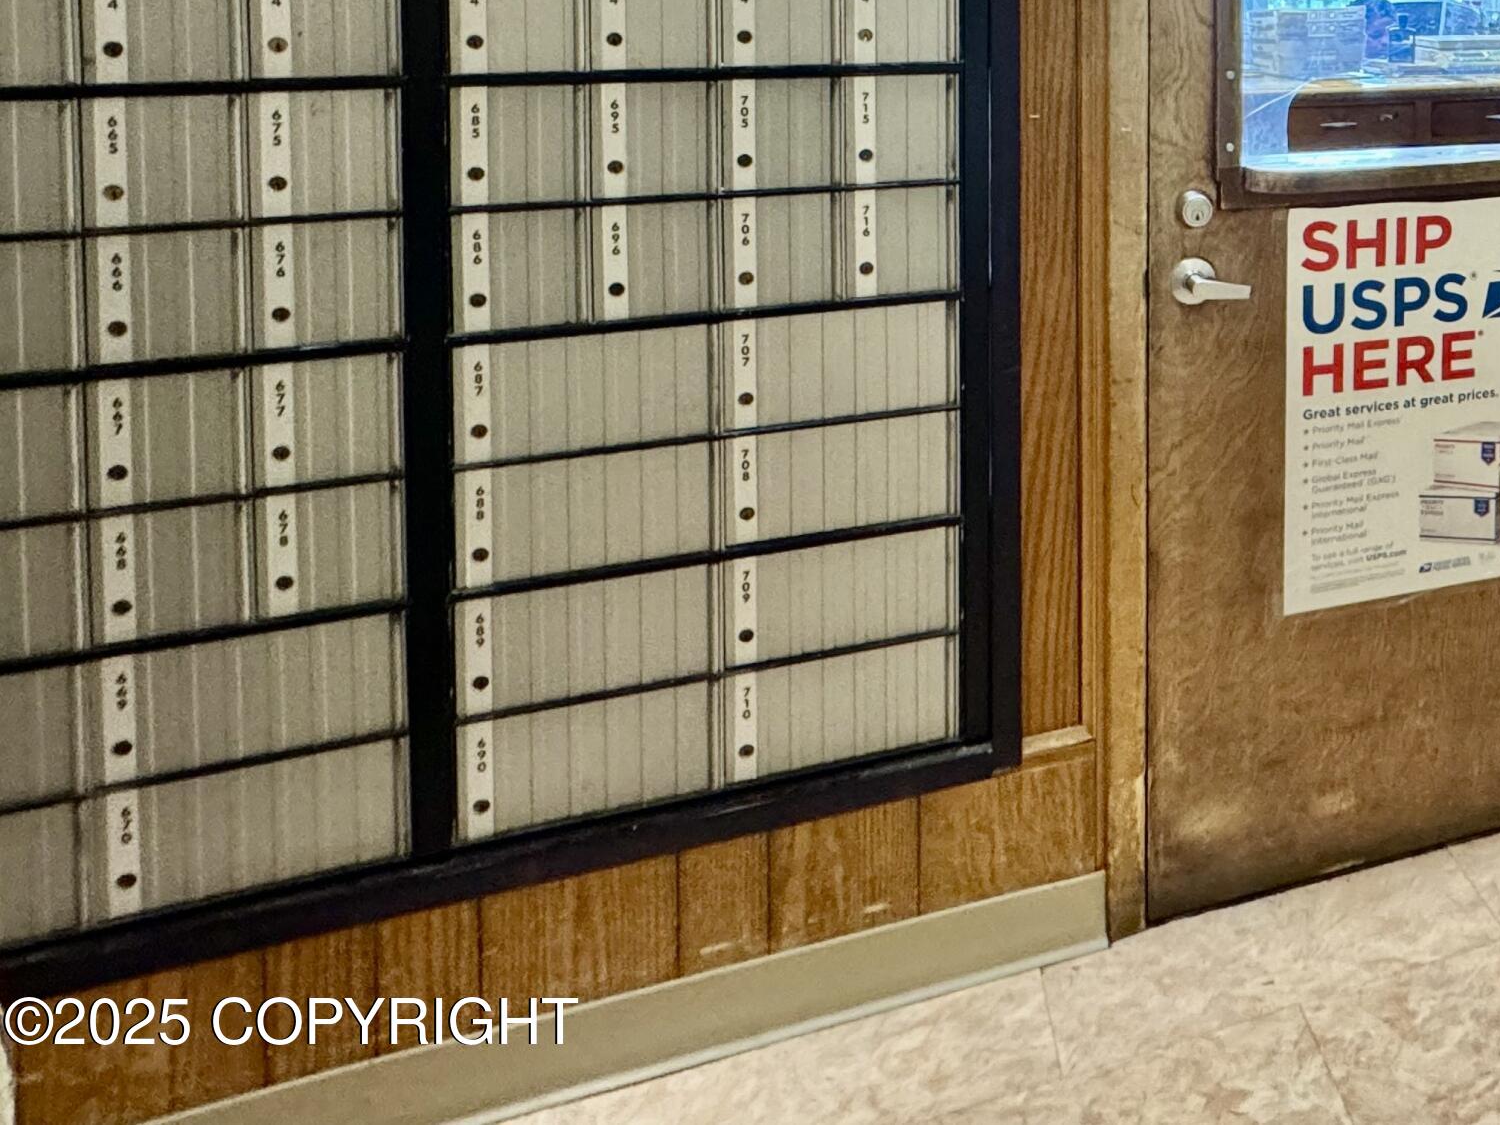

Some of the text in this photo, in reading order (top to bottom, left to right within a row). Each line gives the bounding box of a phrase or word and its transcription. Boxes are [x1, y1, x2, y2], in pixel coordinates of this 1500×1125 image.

[470, 103, 481, 139] 685
[610, 99, 620, 134] 695
[740, 95, 749, 129] 705
[862, 91, 870, 124] 715
[107, 116, 119, 155] 665
[271, 109, 282, 147] 675
[741, 212, 750, 246] 706
[862, 204, 871, 237] 716
[472, 229, 483, 265] 686
[611, 222, 621, 256] 696
[1300, 215, 1452, 272] SHIP
[1302, 273, 1468, 334] USPS
[1302, 330, 1475, 396] HERE
[1303, 389, 1498, 420] Great services at great prices.
[1347, 422, 1364, 430] Mail
